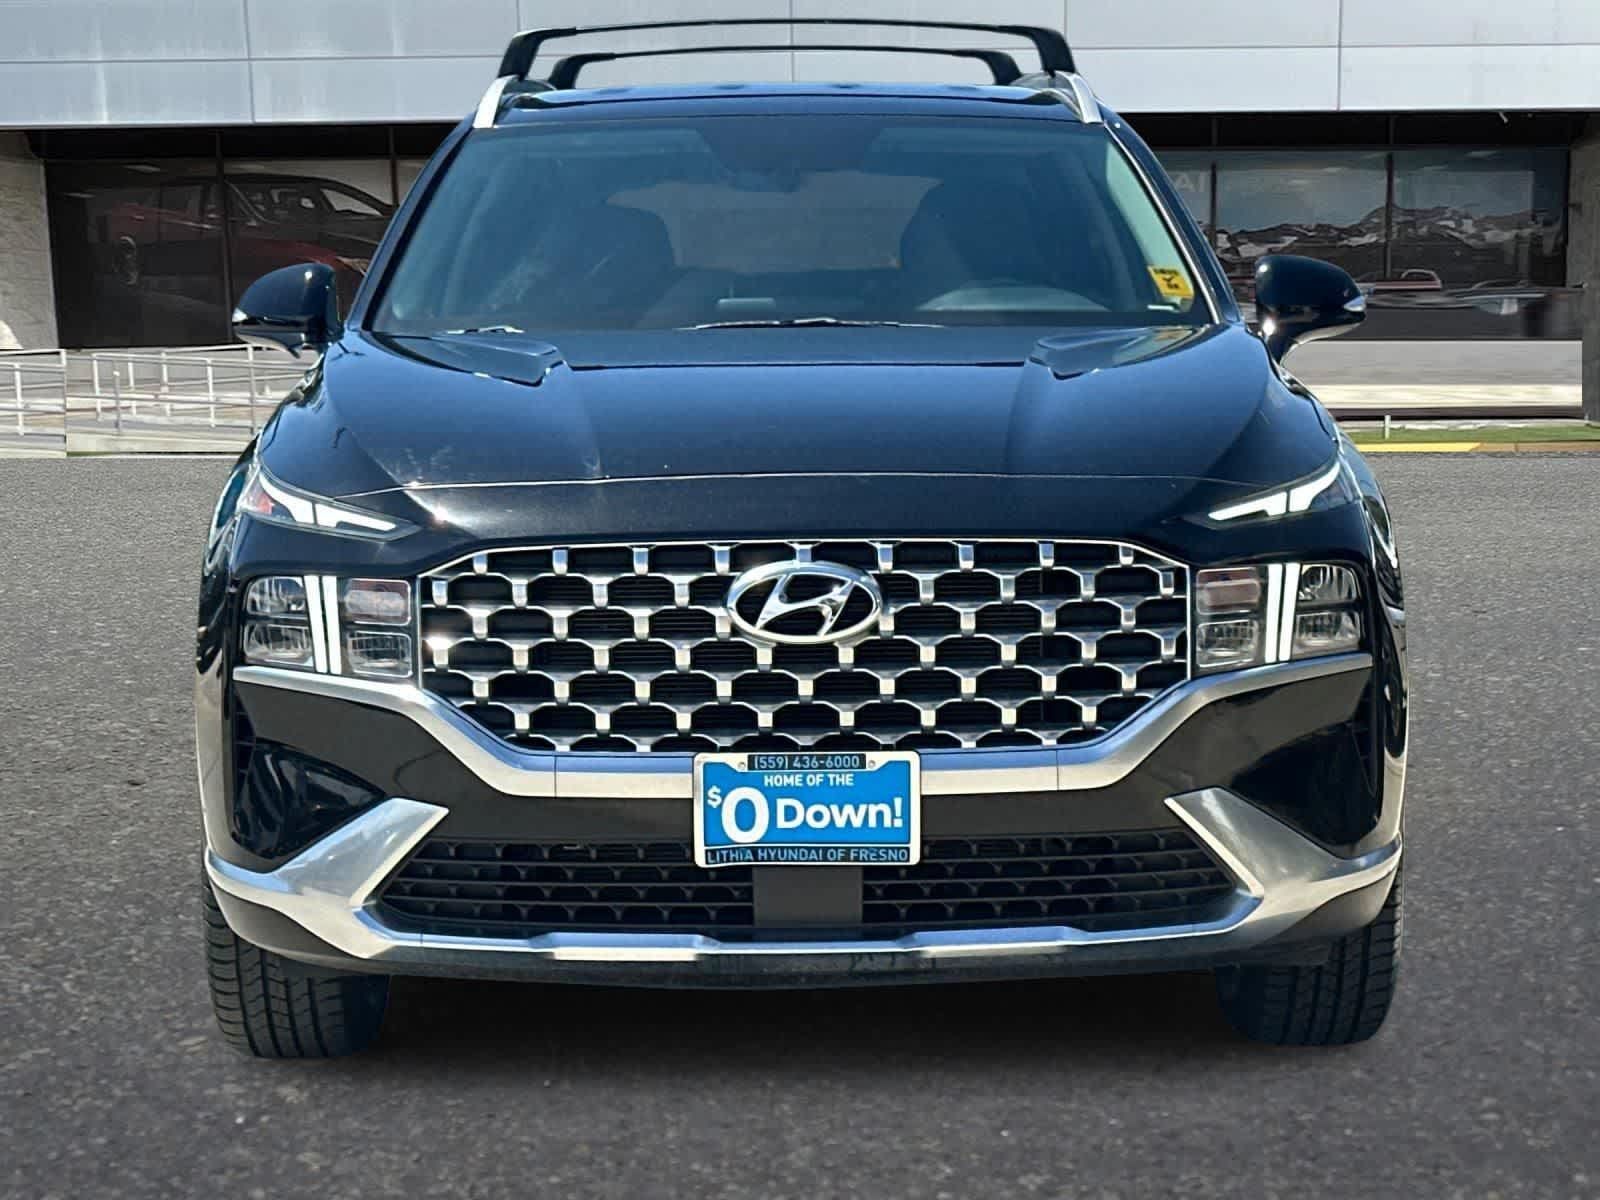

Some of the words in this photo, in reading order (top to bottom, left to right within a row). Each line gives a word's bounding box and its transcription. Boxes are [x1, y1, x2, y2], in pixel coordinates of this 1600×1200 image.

[754, 756, 788, 769] (559)
[793, 755, 860, 768] 436-6000
[764, 775, 803, 787] HOME
[806, 775, 824, 786] OF
[827, 774, 854, 786] THE
[707, 785, 770, 843] $0
[776, 797, 904, 829] Down!
[707, 849, 753, 864] LITHIA
[758, 849, 823, 861] HYUNDAI
[827, 849, 845, 860] OF
[850, 849, 908, 861] FRESNO
